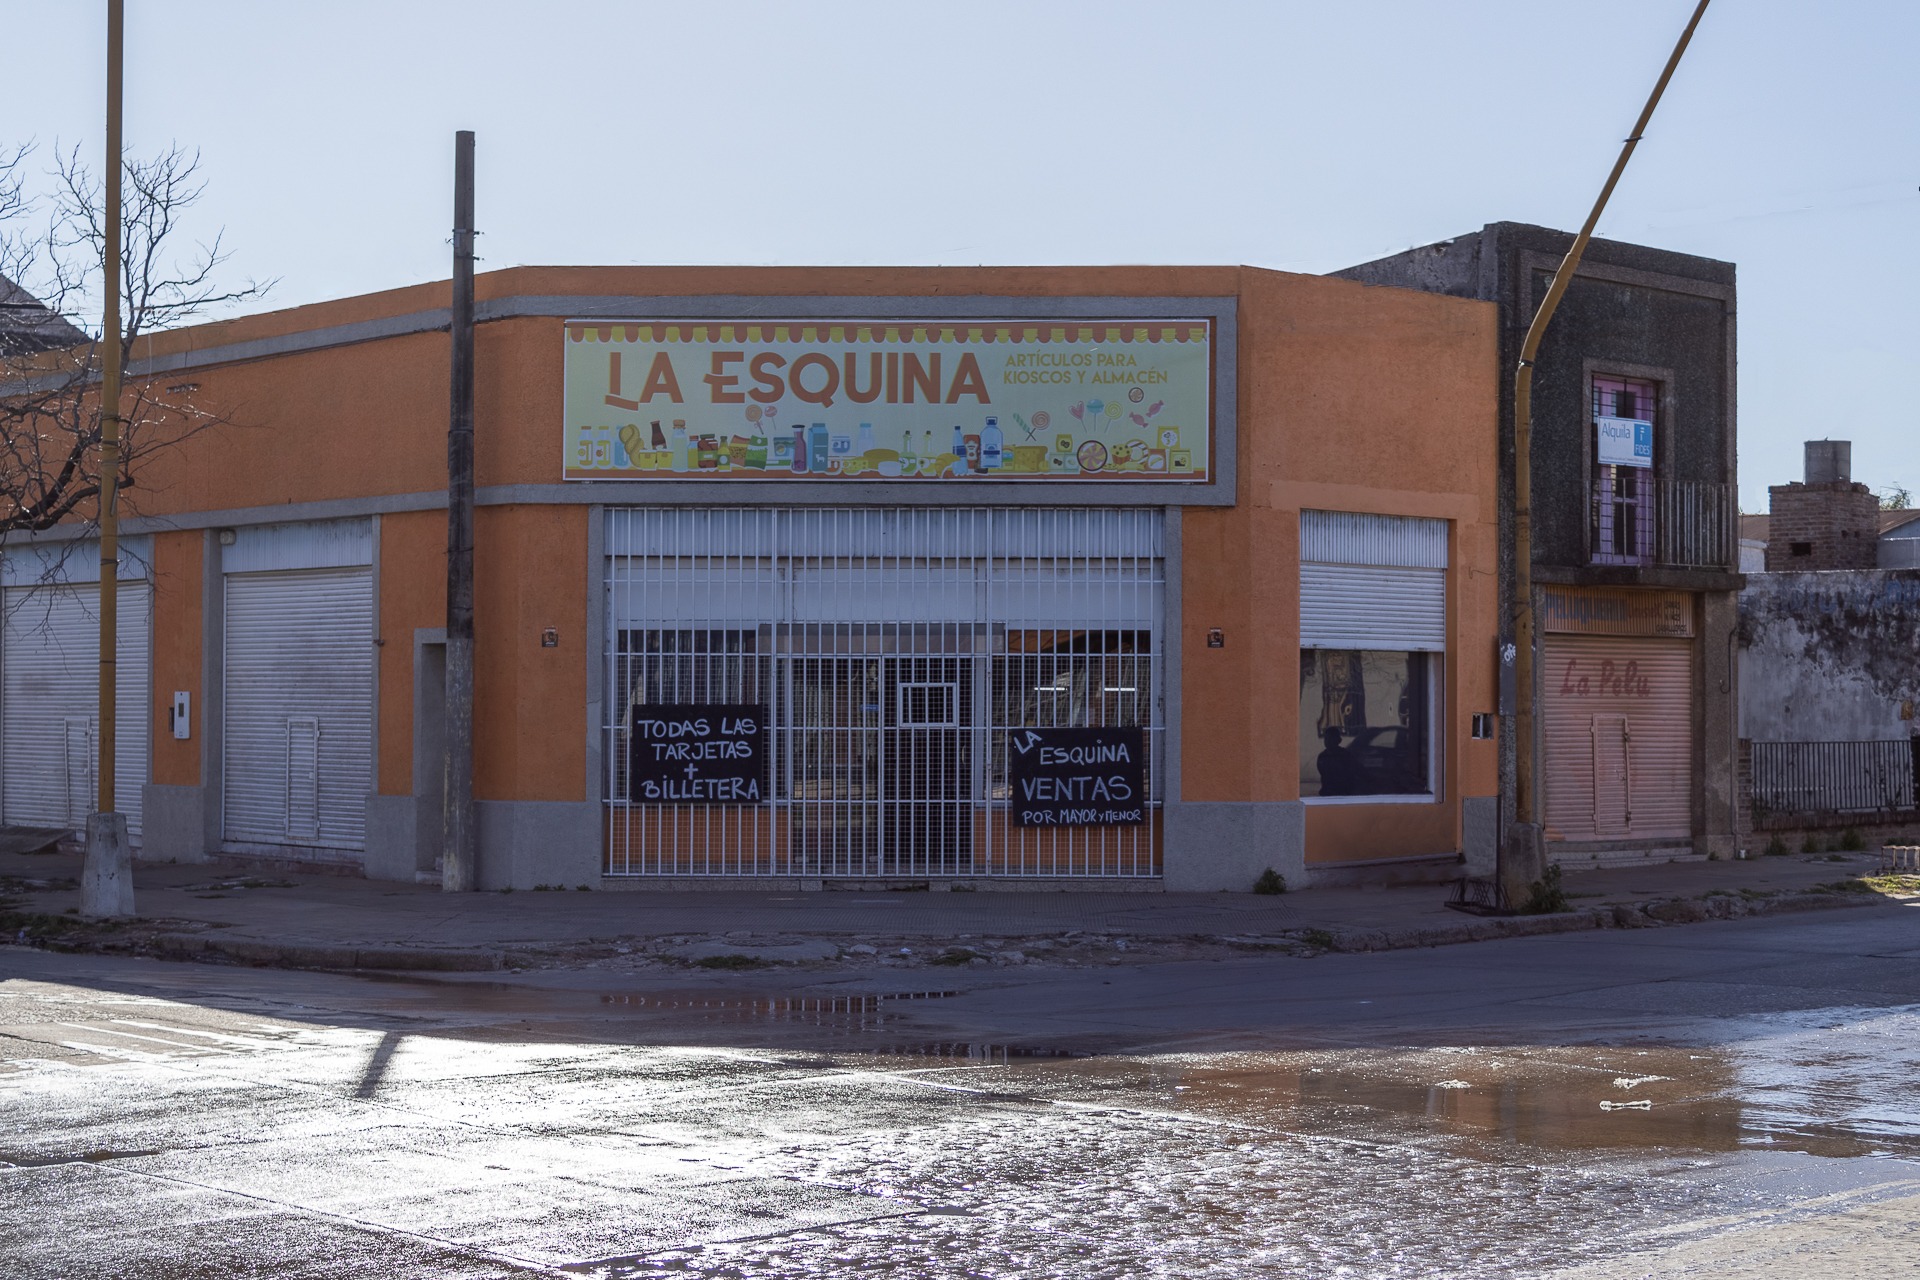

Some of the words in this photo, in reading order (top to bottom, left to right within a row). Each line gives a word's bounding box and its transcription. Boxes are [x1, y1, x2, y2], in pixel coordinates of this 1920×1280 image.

[1005, 349, 1092, 367] ARTÍCULOS
[1097, 352, 1137, 367] PARA
[604, 351, 684, 411] LA
[703, 351, 991, 408] ESQUINA
[1003, 370, 1071, 385] KIOSCOS
[1077, 370, 1086, 384] Y
[1091, 366, 1168, 384] ALMACÉN
[1601, 422, 1631, 442] Alquila
[1635, 444, 1650, 455] FIDES
[1560, 657, 1591, 697] La
[1600, 658, 1651, 697] Pelu
[637, 718, 711, 739] TODAS
[721, 717, 757, 735] LAS
[651, 740, 753, 761] TARJETAS
[1013, 730, 1042, 754] LA
[1021, 775, 1132, 802] VENTAS
[1022, 809, 1057, 825] POR
[1059, 808, 1097, 824] MAYOR
[1105, 809, 1142, 823] MENOR
